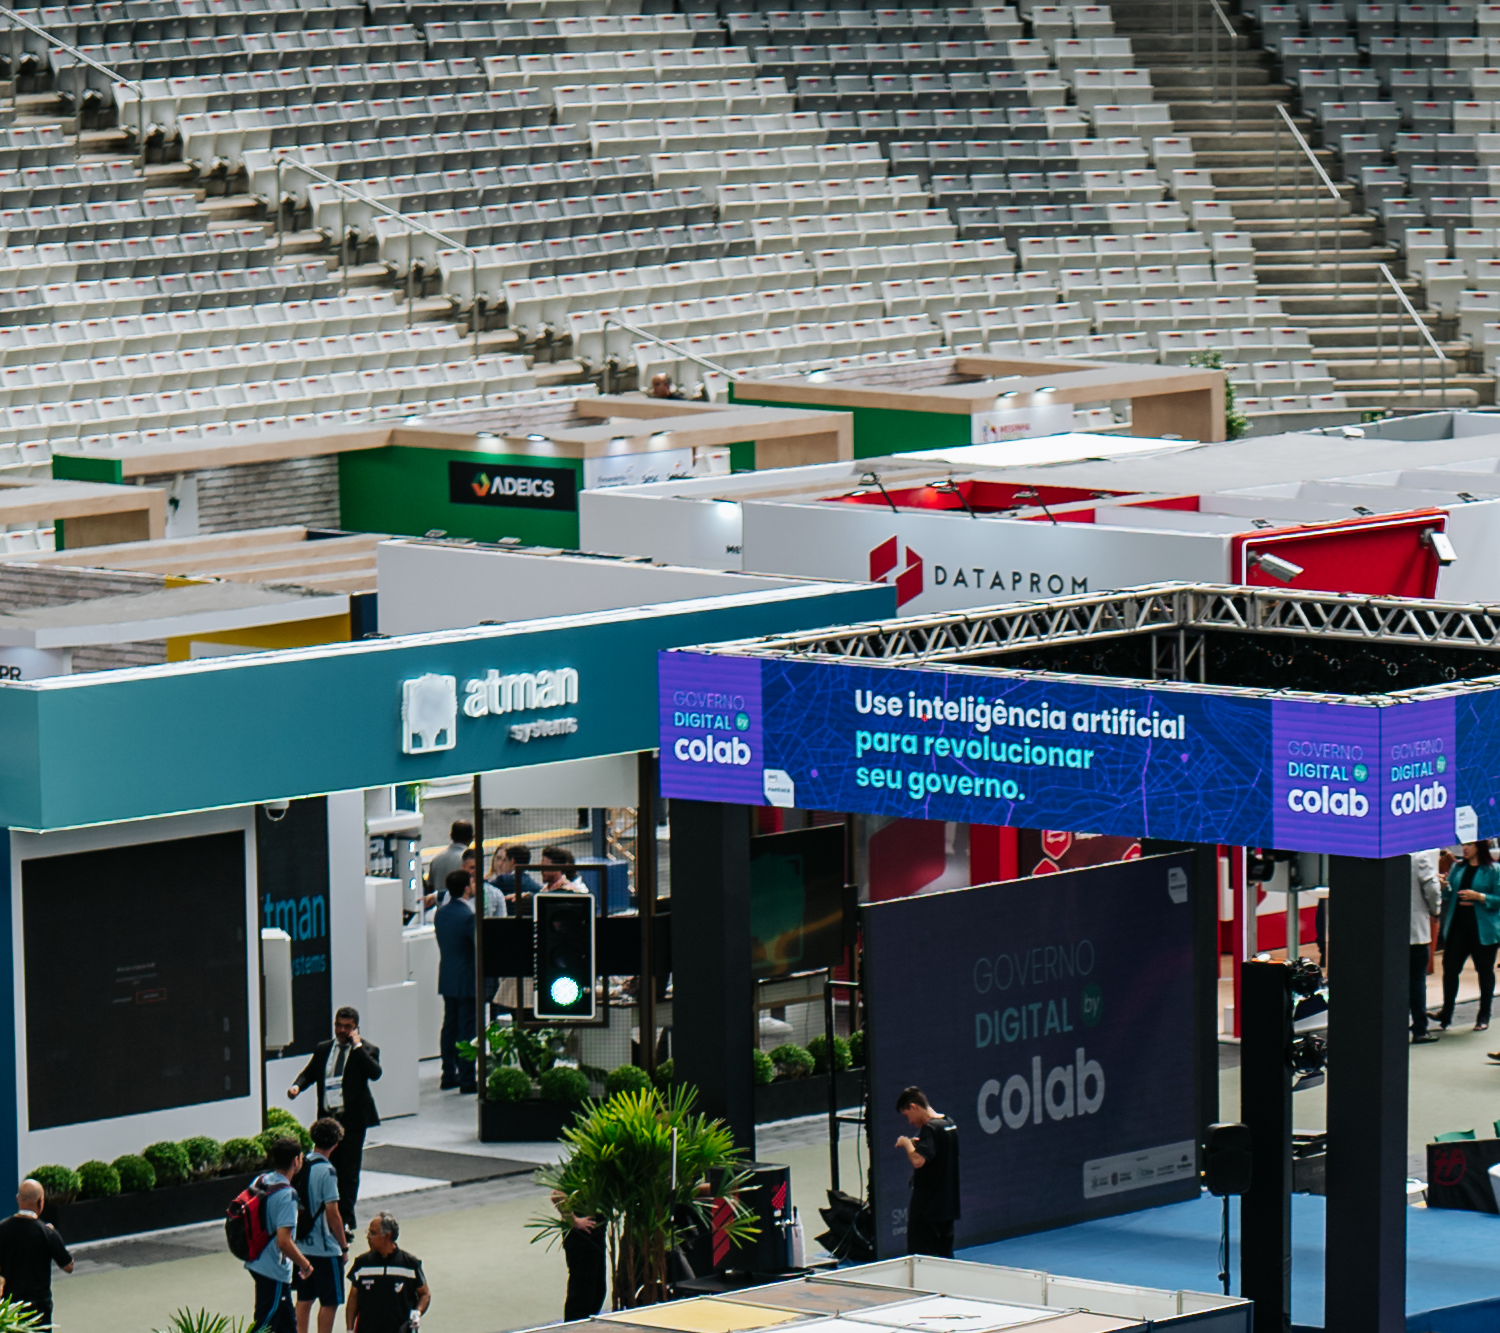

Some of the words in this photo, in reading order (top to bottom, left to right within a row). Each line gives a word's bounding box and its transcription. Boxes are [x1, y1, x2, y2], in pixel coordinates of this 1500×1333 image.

[491, 473, 555, 500] ADEICS
[934, 564, 1088, 597] DATAPROM
[462, 664, 579, 719] atman
[673, 690, 745, 711] GOVERNO
[510, 716, 578, 744] systems
[673, 711, 731, 731] DIGITAL
[855, 689, 903, 716] Use
[908, 694, 1067, 733] inteligência
[1072, 708, 1185, 741] artificial
[674, 734, 751, 766] colab
[855, 729, 918, 759] para
[923, 734, 1094, 769] revolucionar
[1287, 739, 1364, 760] GOVERNO
[1390, 738, 1444, 762] GOVERNO
[855, 764, 903, 789] seu
[909, 768, 1026, 801] governo.
[1287, 760, 1349, 782] DIGITAL
[1390, 760, 1434, 782] DIGITAL
[1287, 785, 1369, 819] colab
[1390, 780, 1448, 817] colab
[973, 939, 1095, 994] GOVERNO
[975, 998, 1073, 1048] DIGITAL
[977, 1047, 1105, 1134] colab
